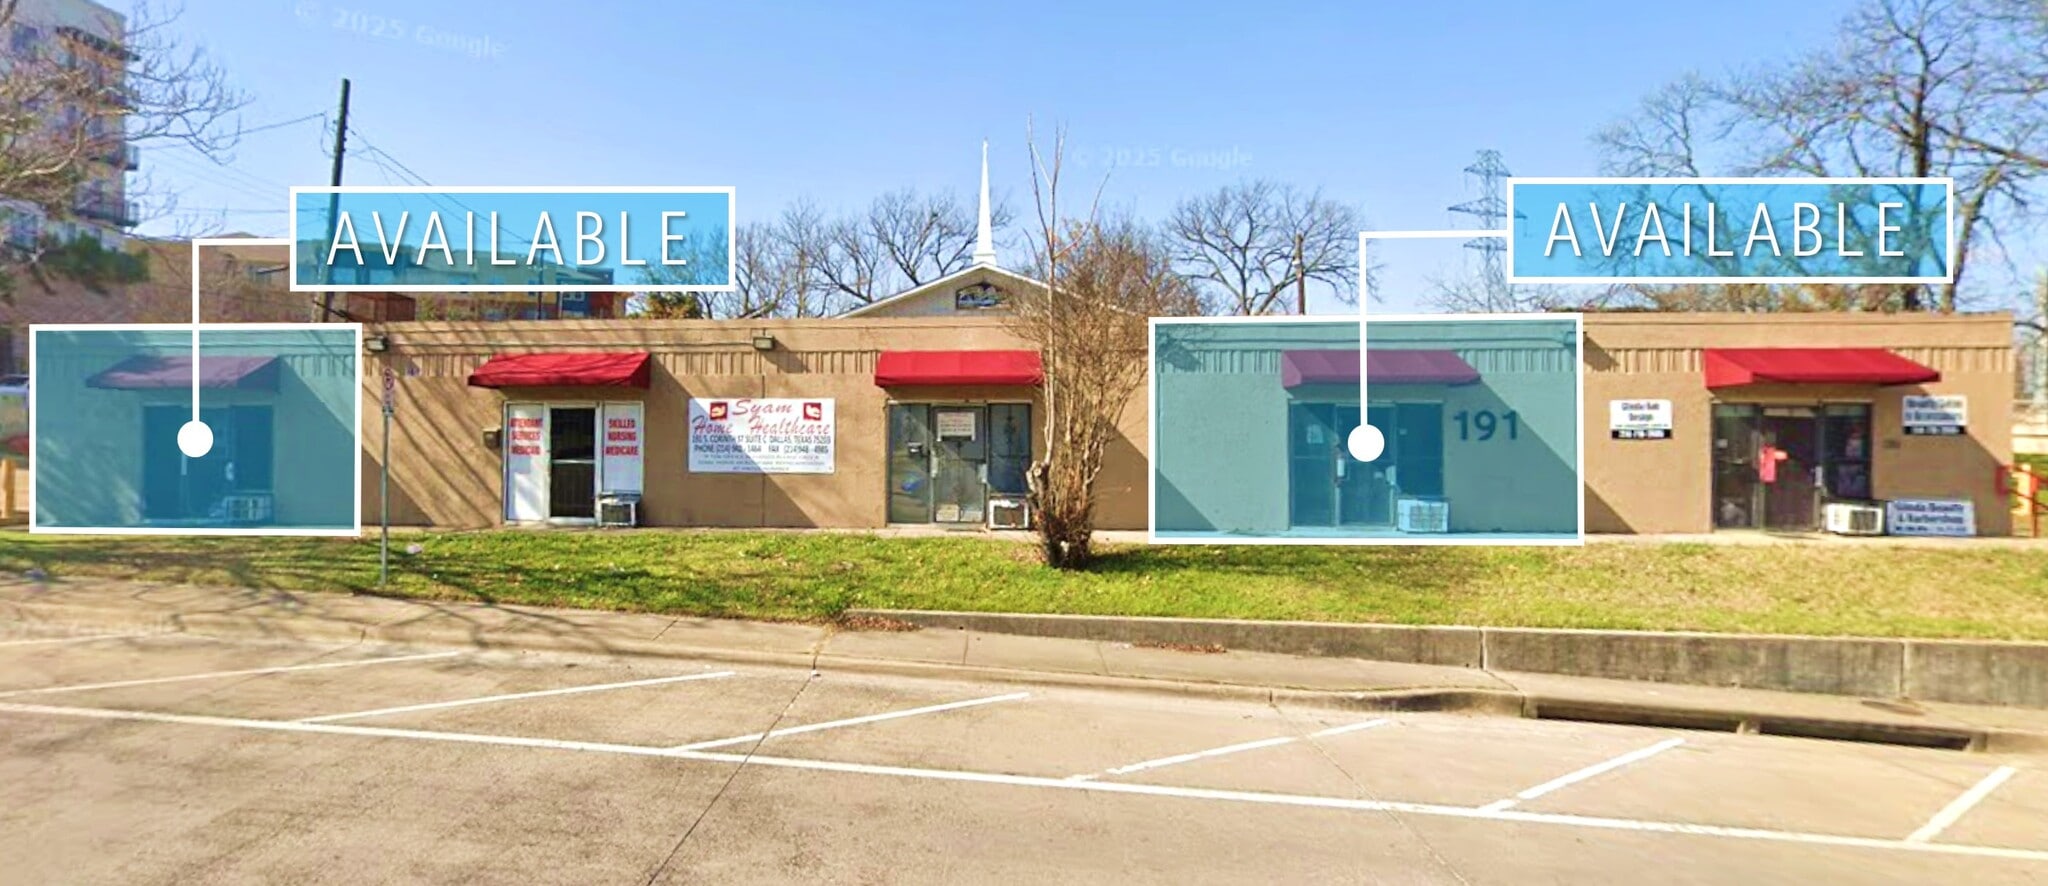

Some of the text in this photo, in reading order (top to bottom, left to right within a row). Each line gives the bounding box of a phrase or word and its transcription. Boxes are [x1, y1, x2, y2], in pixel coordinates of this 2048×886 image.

[732, 399, 793, 416] Syam
[608, 418, 636, 429] SKILLED
[692, 413, 831, 435] Home Healthcare
[1454, 410, 1518, 441] 191
[512, 431, 541, 441] SERVICES
[608, 431, 637, 441] NURSING
[794, 435, 812, 444] TEXAS
[605, 445, 639, 455] MEDICARE
[769, 445, 780, 453] FAX
